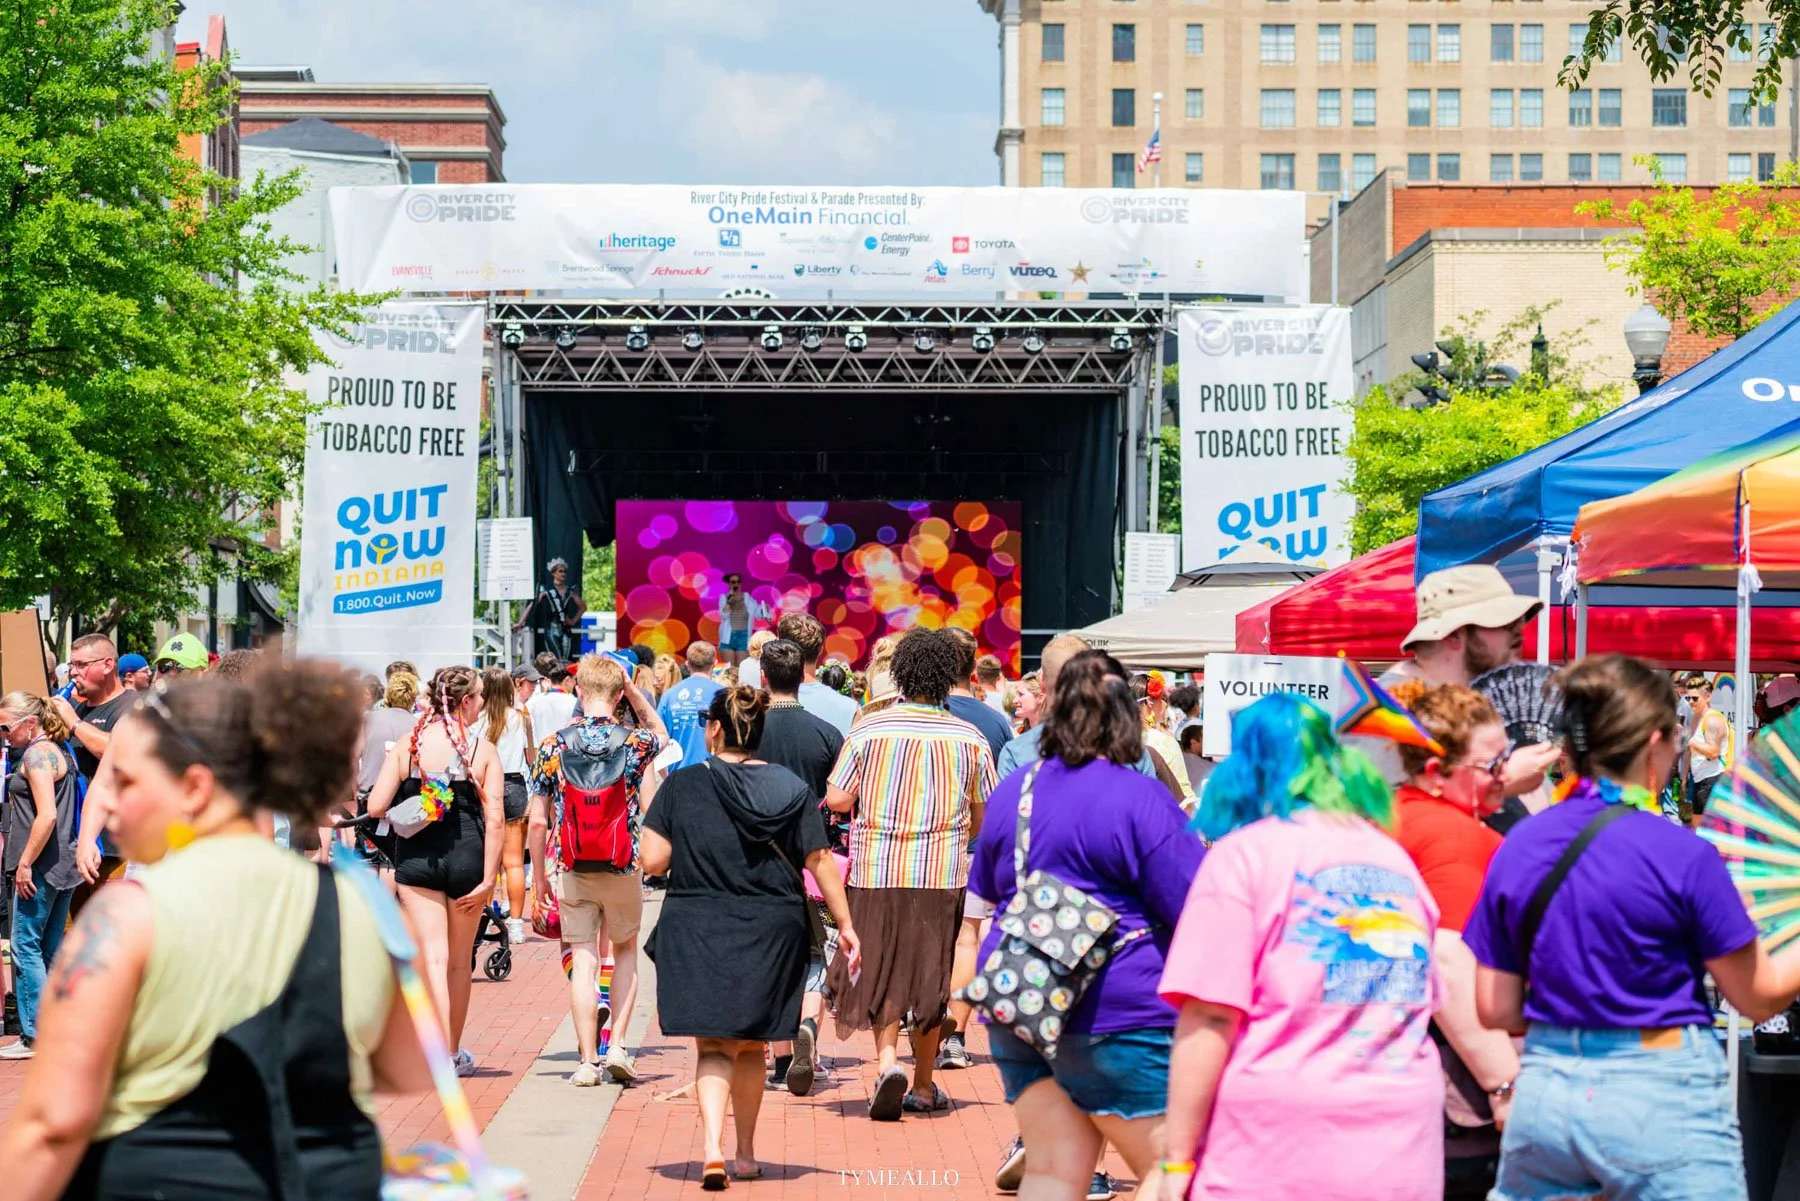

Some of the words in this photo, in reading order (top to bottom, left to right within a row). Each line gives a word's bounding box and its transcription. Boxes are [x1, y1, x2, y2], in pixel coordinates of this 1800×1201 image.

[438, 194, 483, 204] RIVER
[485, 194, 516, 203] CITY
[691, 191, 716, 204] River
[719, 191, 738, 207] City
[741, 191, 767, 204] Pride
[770, 191, 808, 205] Festival
[811, 192, 818, 204] &
[821, 193, 855, 206] Parade
[858, 193, 908, 206] Presented
[911, 193, 926, 208] By:
[1113, 197, 1157, 206] RIVER
[1159, 197, 1190, 206] CITY
[438, 205, 516, 222] PRIDE
[708, 206, 812, 224] OneMain
[1113, 208, 1190, 224] PRIDE
[612, 233, 676, 251] heritage
[881, 233, 930, 243] CenterPoint
[975, 240, 1015, 249] TOYOTA
[881, 245, 910, 256] Energy
[391, 265, 432, 276] EVANSVILLE
[562, 264, 604, 273] Brentwood
[606, 264, 634, 275] Springs
[807, 264, 841, 275] Liberty
[962, 263, 995, 279] Berry
[1232, 319, 1286, 332] RIVER
[366, 328, 456, 354] PRIDE
[1234, 333, 1324, 356] PRIDE
[328, 376, 394, 407] PROUD
[402, 380, 426, 409] TO
[432, 382, 457, 410] BE
[1201, 383, 1266, 412] PROUD
[1273, 382, 1298, 410] TO
[1306, 382, 1329, 410] BE
[320, 421, 412, 455] TOBACCO
[419, 427, 465, 457] FREE
[1195, 428, 1287, 458] TOBACCO
[1296, 427, 1341, 456] FREE
[337, 483, 448, 535] QUIT
[1218, 483, 1326, 541] QUIT
[338, 588, 436, 612] 1.800.Quit.Now
[1219, 680, 1329, 700] VOLUNTEER
